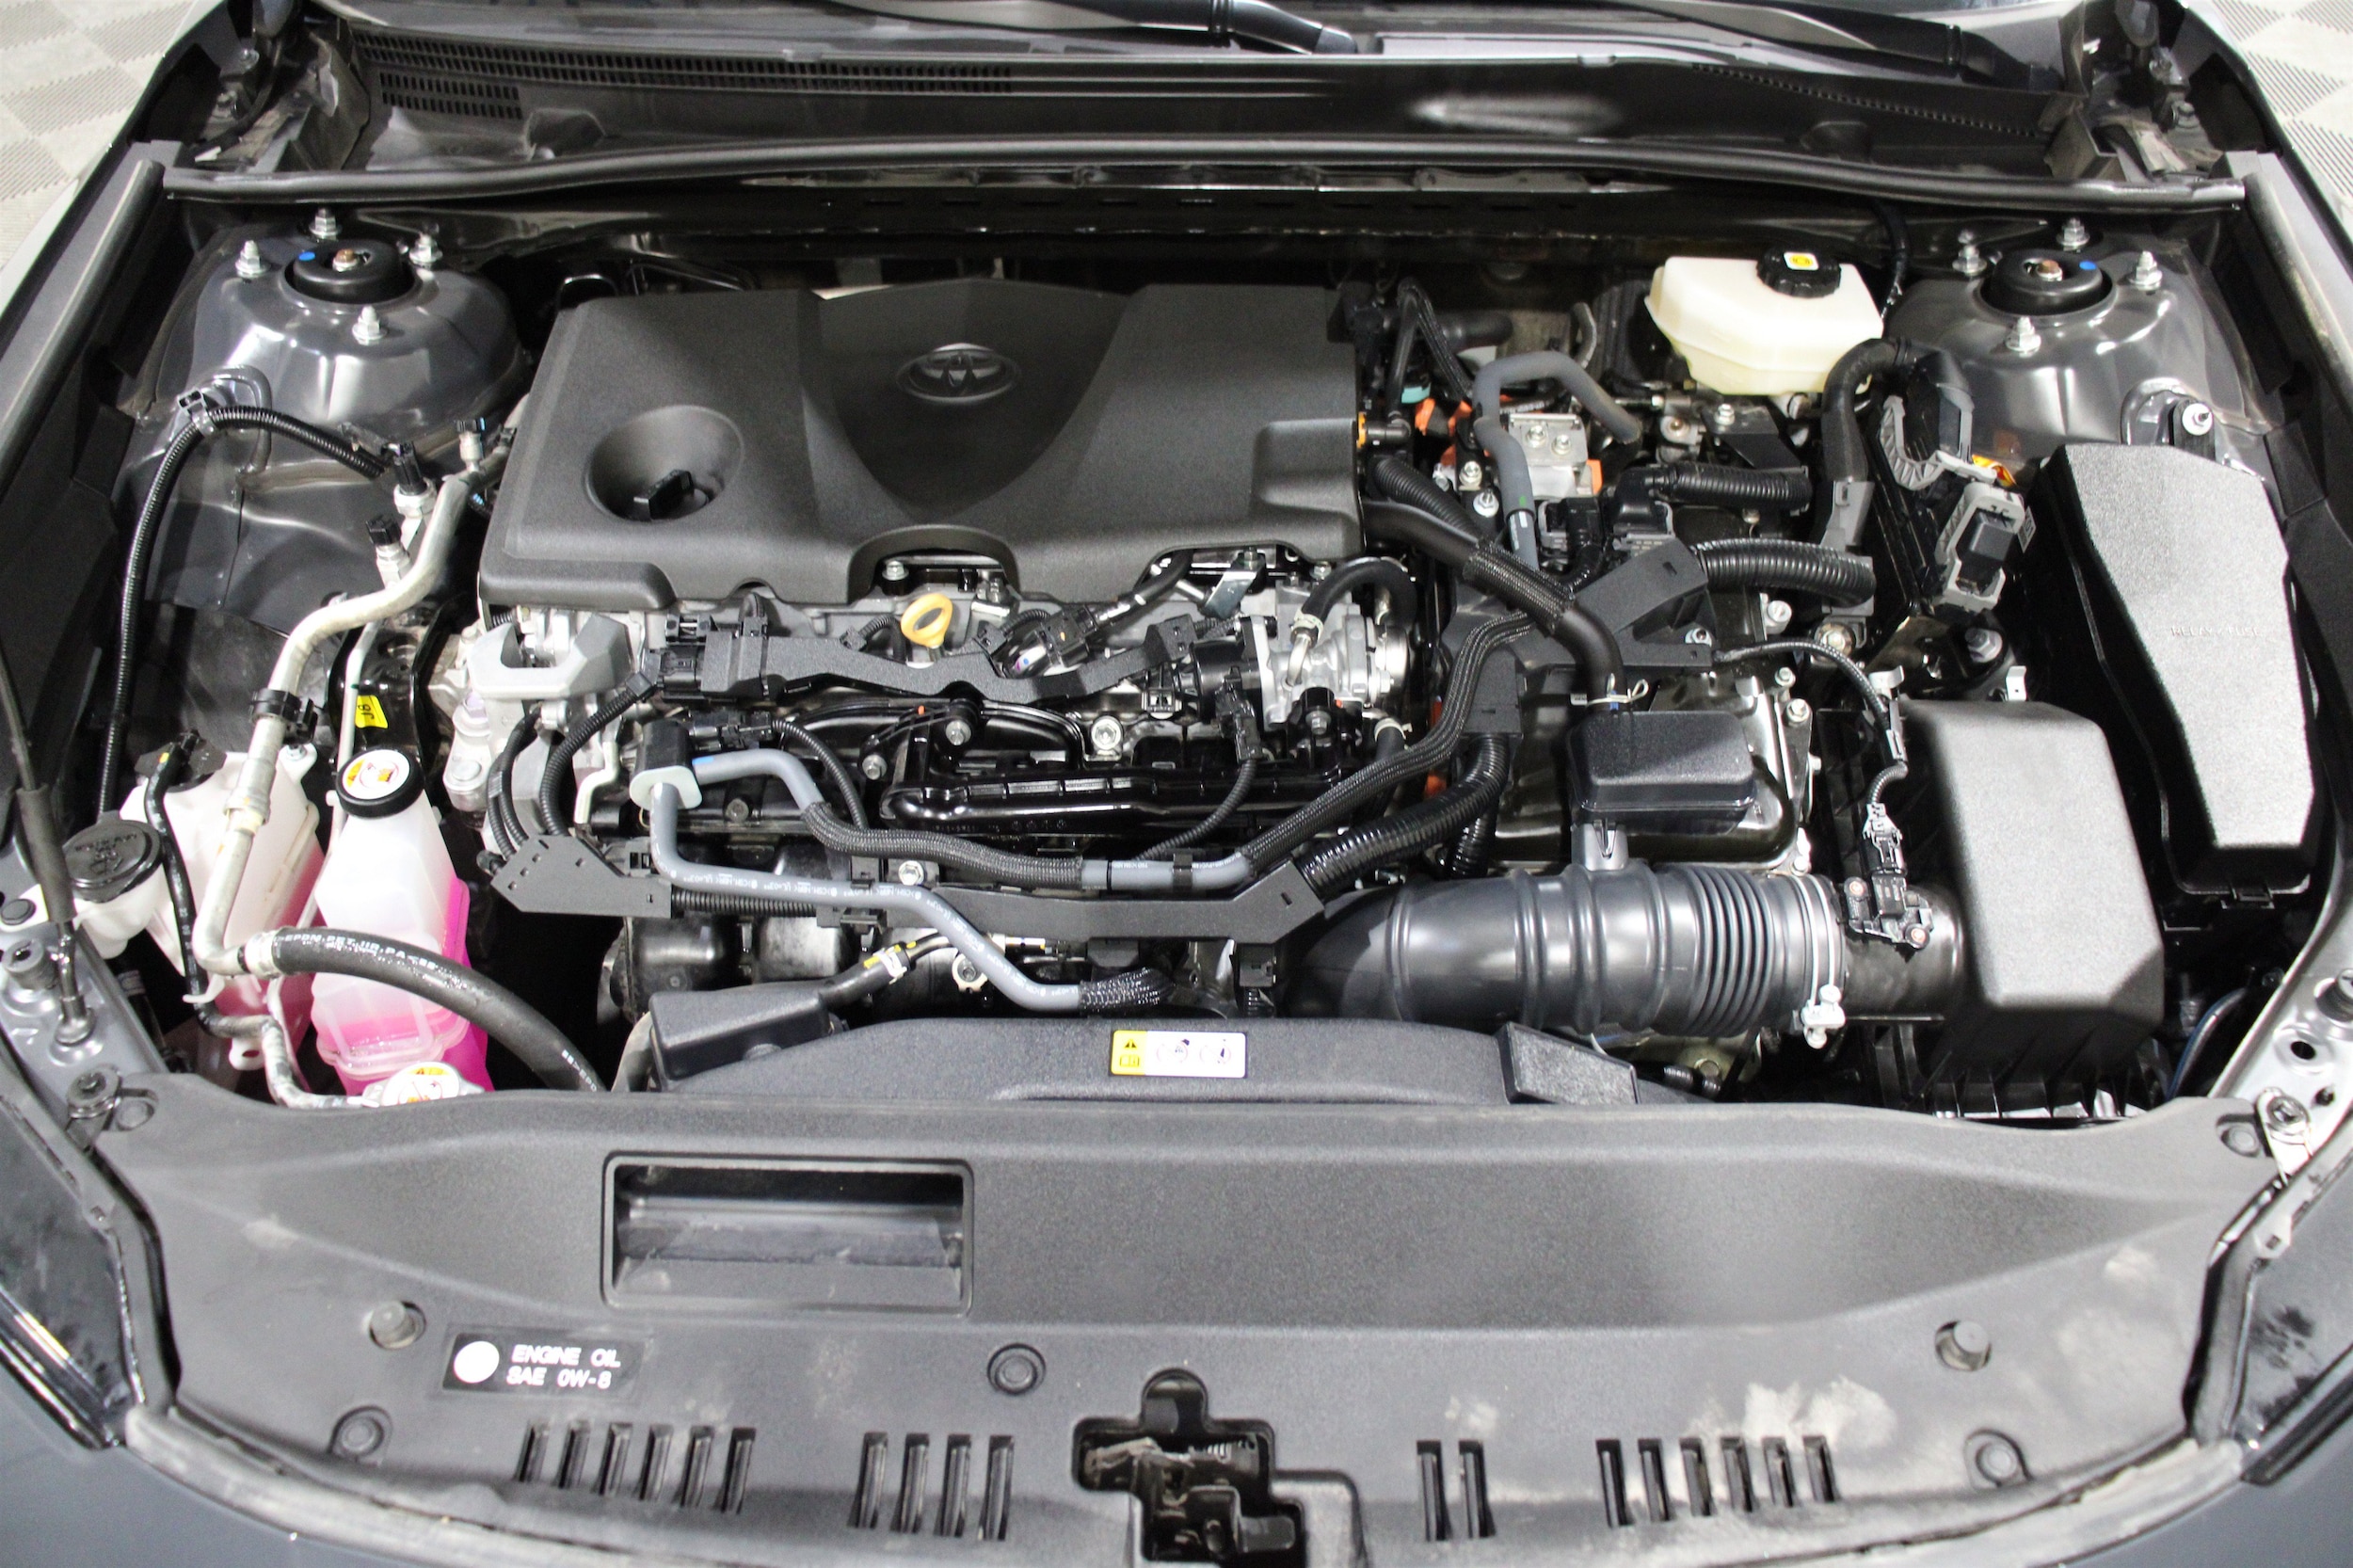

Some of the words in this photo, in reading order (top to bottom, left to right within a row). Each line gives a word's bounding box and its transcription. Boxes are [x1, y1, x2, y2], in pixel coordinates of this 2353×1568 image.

[512, 1344, 582, 1365] ENGINE
[590, 1349, 621, 1368] OIL
[506, 1366, 547, 1385] SAE
[556, 1368, 612, 1389] 0W-8
